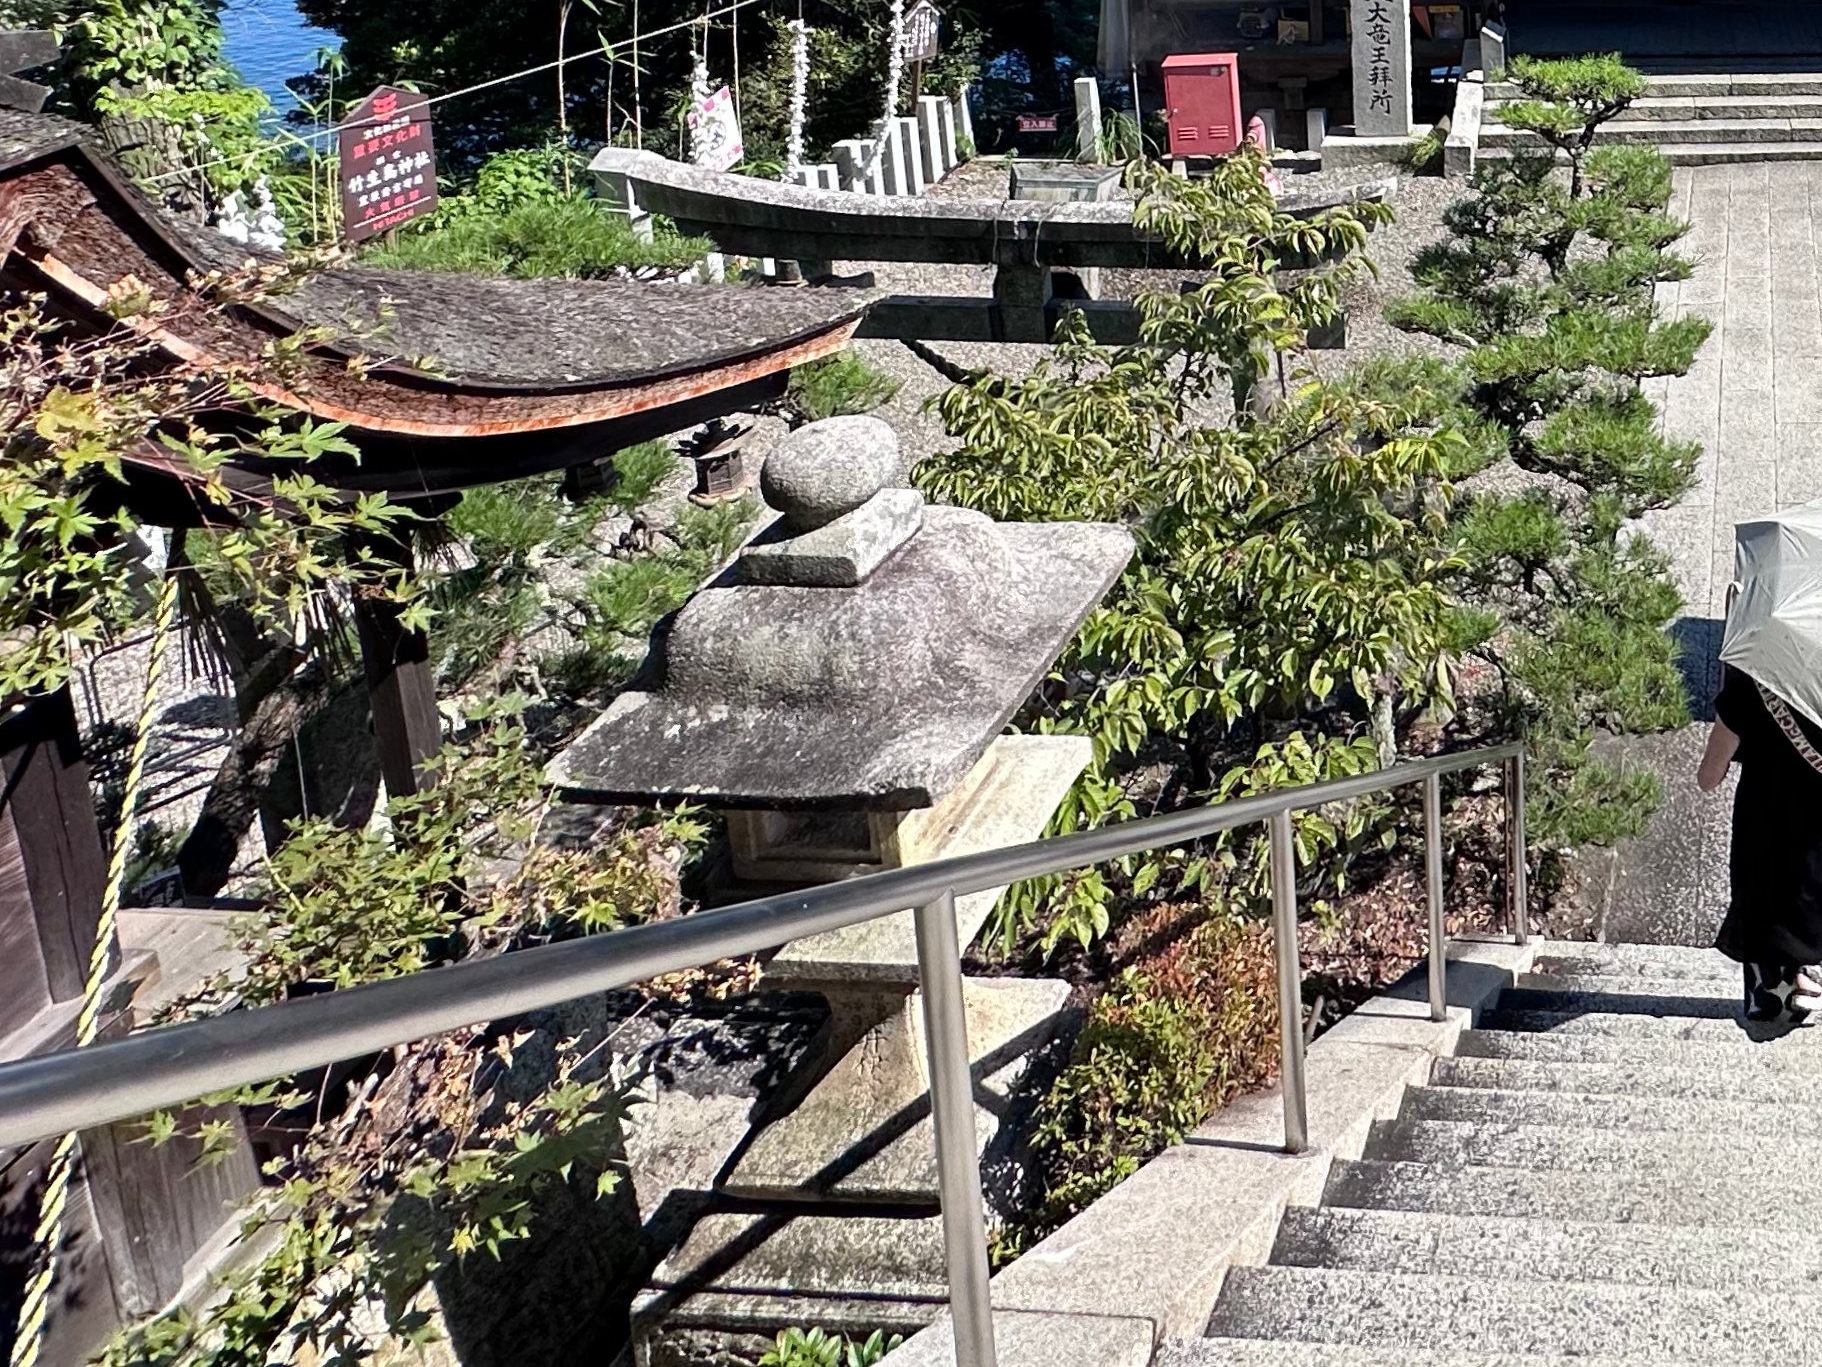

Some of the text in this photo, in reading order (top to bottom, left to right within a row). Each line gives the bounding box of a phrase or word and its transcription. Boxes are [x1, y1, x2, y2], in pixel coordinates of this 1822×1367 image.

[348, 150, 431, 195] 竹生島神社
[373, 210, 413, 231] HITACHI
